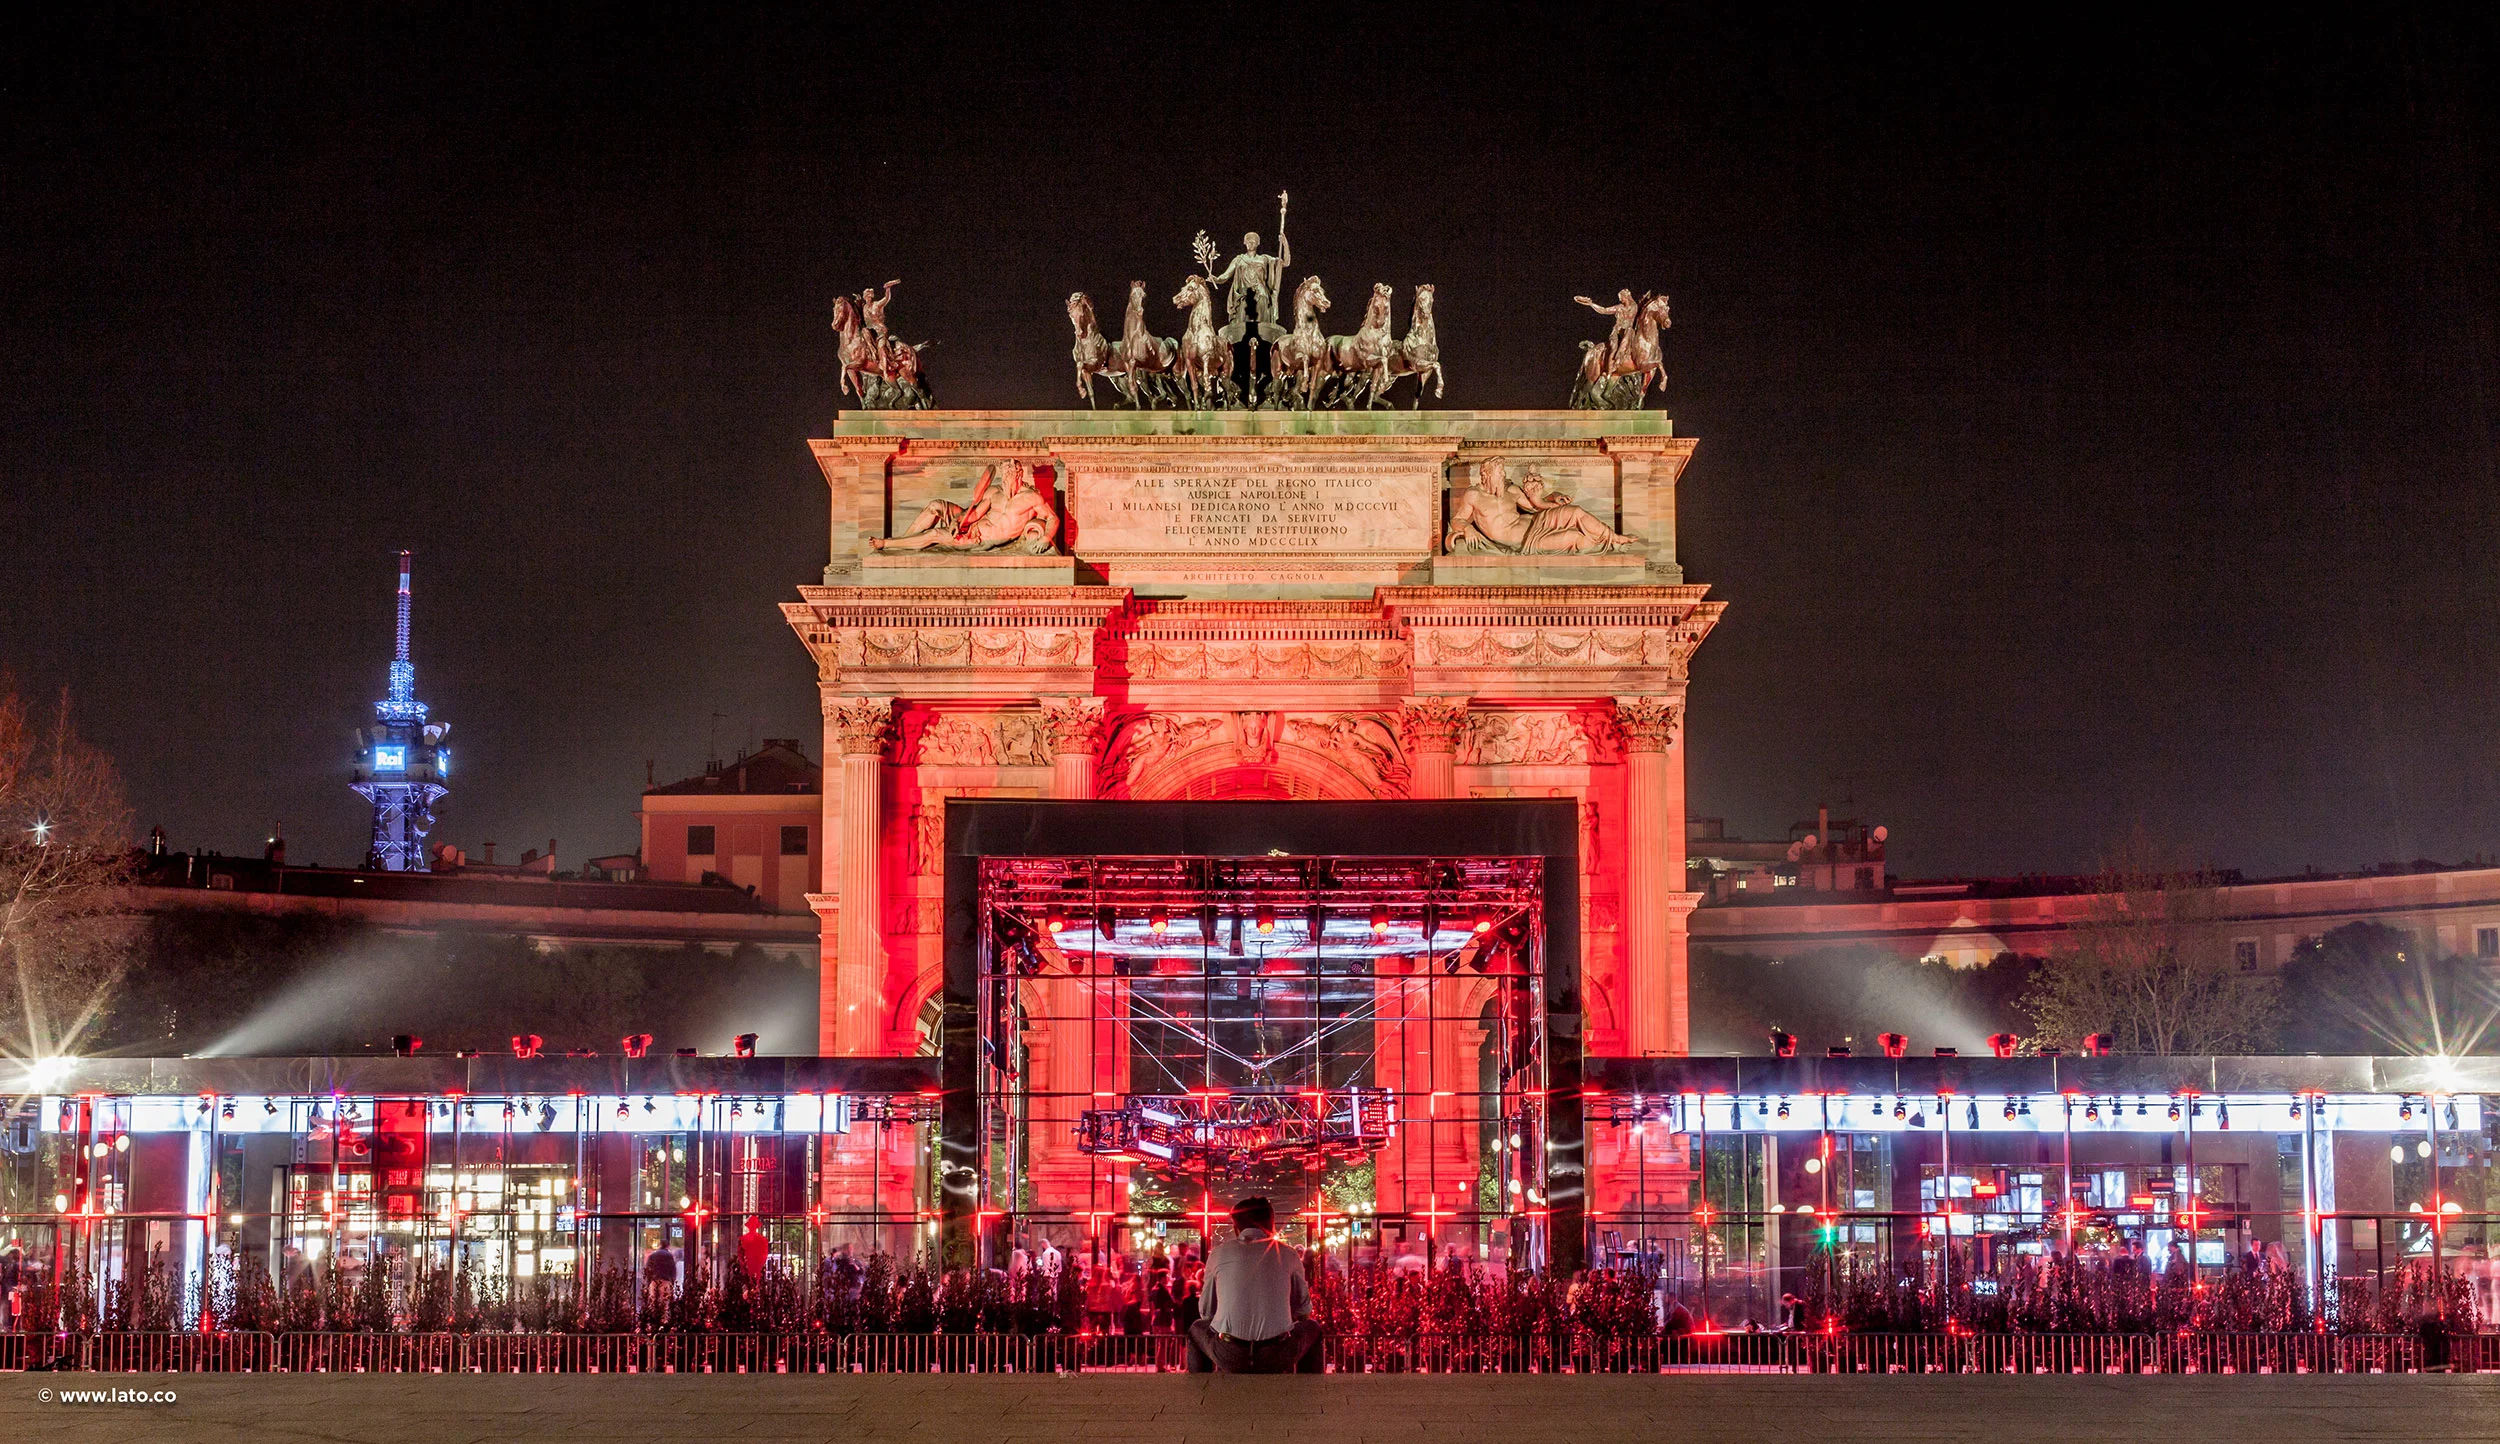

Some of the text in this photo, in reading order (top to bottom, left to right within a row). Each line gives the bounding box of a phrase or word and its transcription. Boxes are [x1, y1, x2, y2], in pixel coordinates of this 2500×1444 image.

[1134, 479, 1373, 488] ALLE SPERANZE DEL REGNO ITALICO
[1187, 491, 1231, 500] AUSPICE
[1240, 491, 1307, 500] NAPOLEONE
[1122, 502, 1181, 511] MILANESI
[1191, 502, 1271, 512] DEDICARONO
[1292, 502, 1325, 512] ANNO
[1334, 502, 1398, 512] MDCCCVII
[1174, 514, 1337, 523] E FRANCATI DA SERVITU
[1165, 526, 1348, 535] FELICEMENTE RESTITUIRONO
[1205, 538, 1240, 546] ANNO
[1249, 538, 1318, 546] MDCCCLIX
[1183, 573, 1325, 581] ARCHITETTO CAGNOLA
[377, 751, 403, 766] Rai
